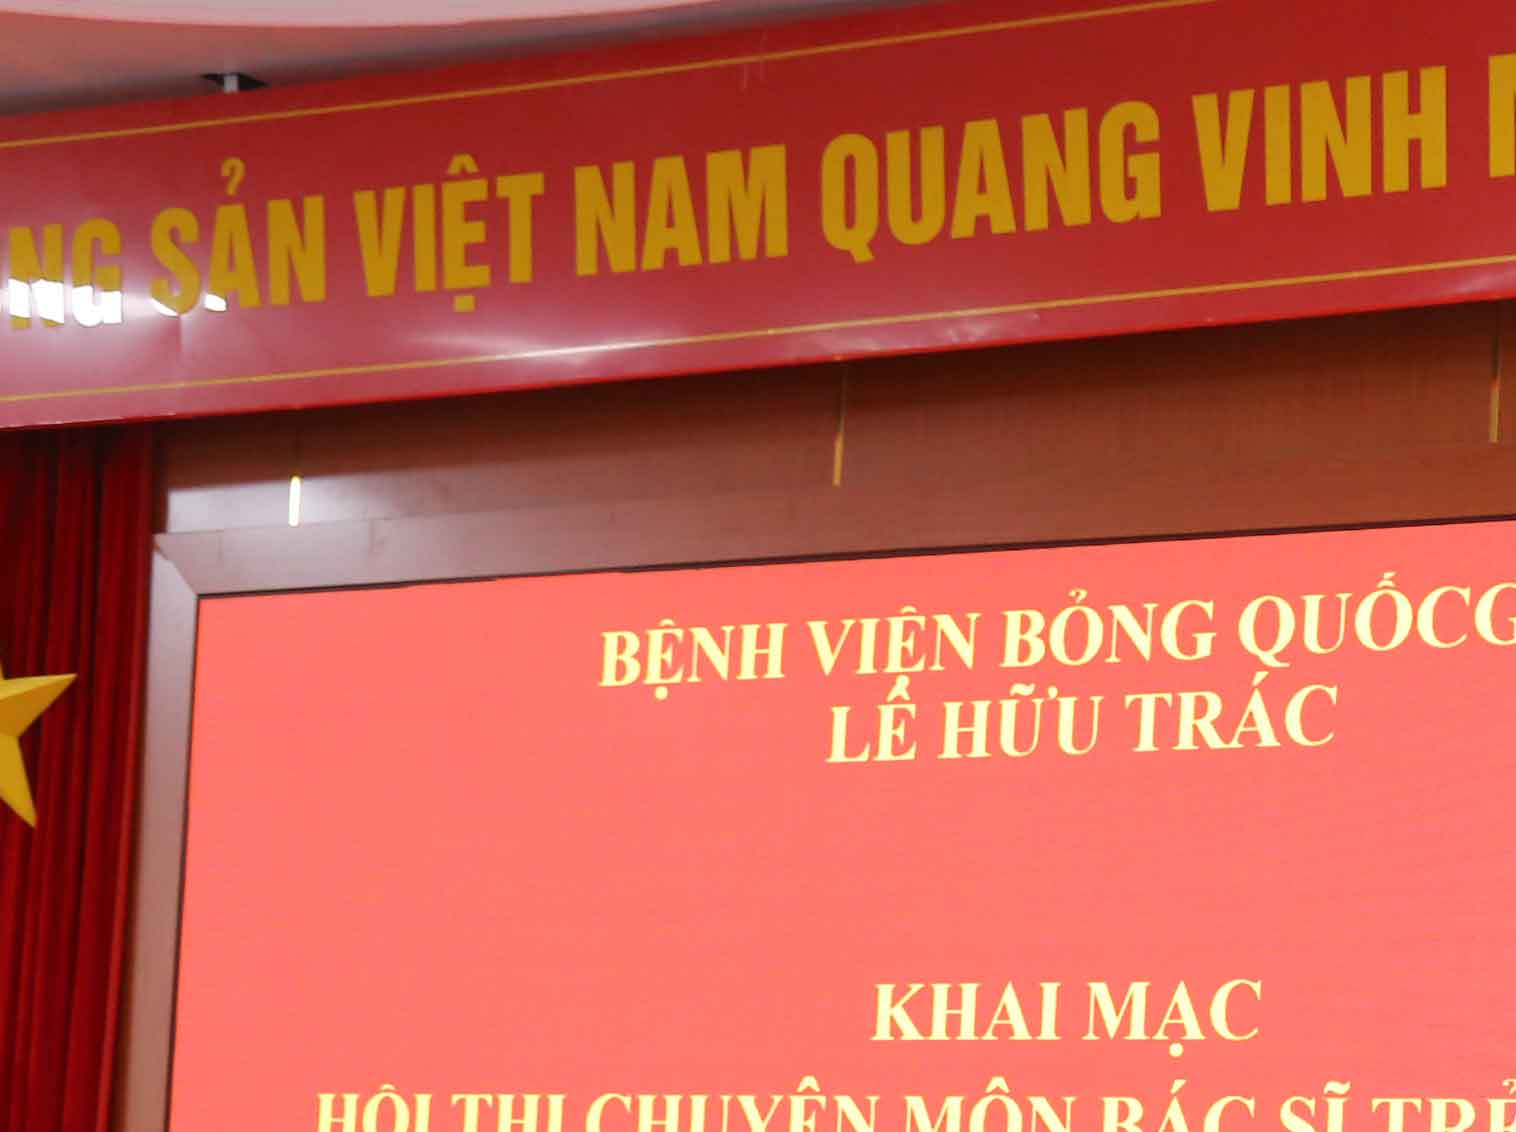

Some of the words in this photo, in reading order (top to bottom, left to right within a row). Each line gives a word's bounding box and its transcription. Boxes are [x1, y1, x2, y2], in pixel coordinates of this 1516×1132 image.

[151, 157, 326, 312] SẢN
[355, 154, 544, 313] VIỆT
[574, 144, 788, 278] NAM
[821, 100, 1162, 263] QUANG
[1192, 65, 1446, 213] VINH
[599, 619, 787, 700] BỆNH
[1000, 589, 1216, 667] BỎNG
[938, 684, 1103, 759] HỮU
[1125, 671, 1337, 752] TRÁC
[871, 981, 1061, 1040] KHAI
[1082, 979, 1262, 1057] MẠC
